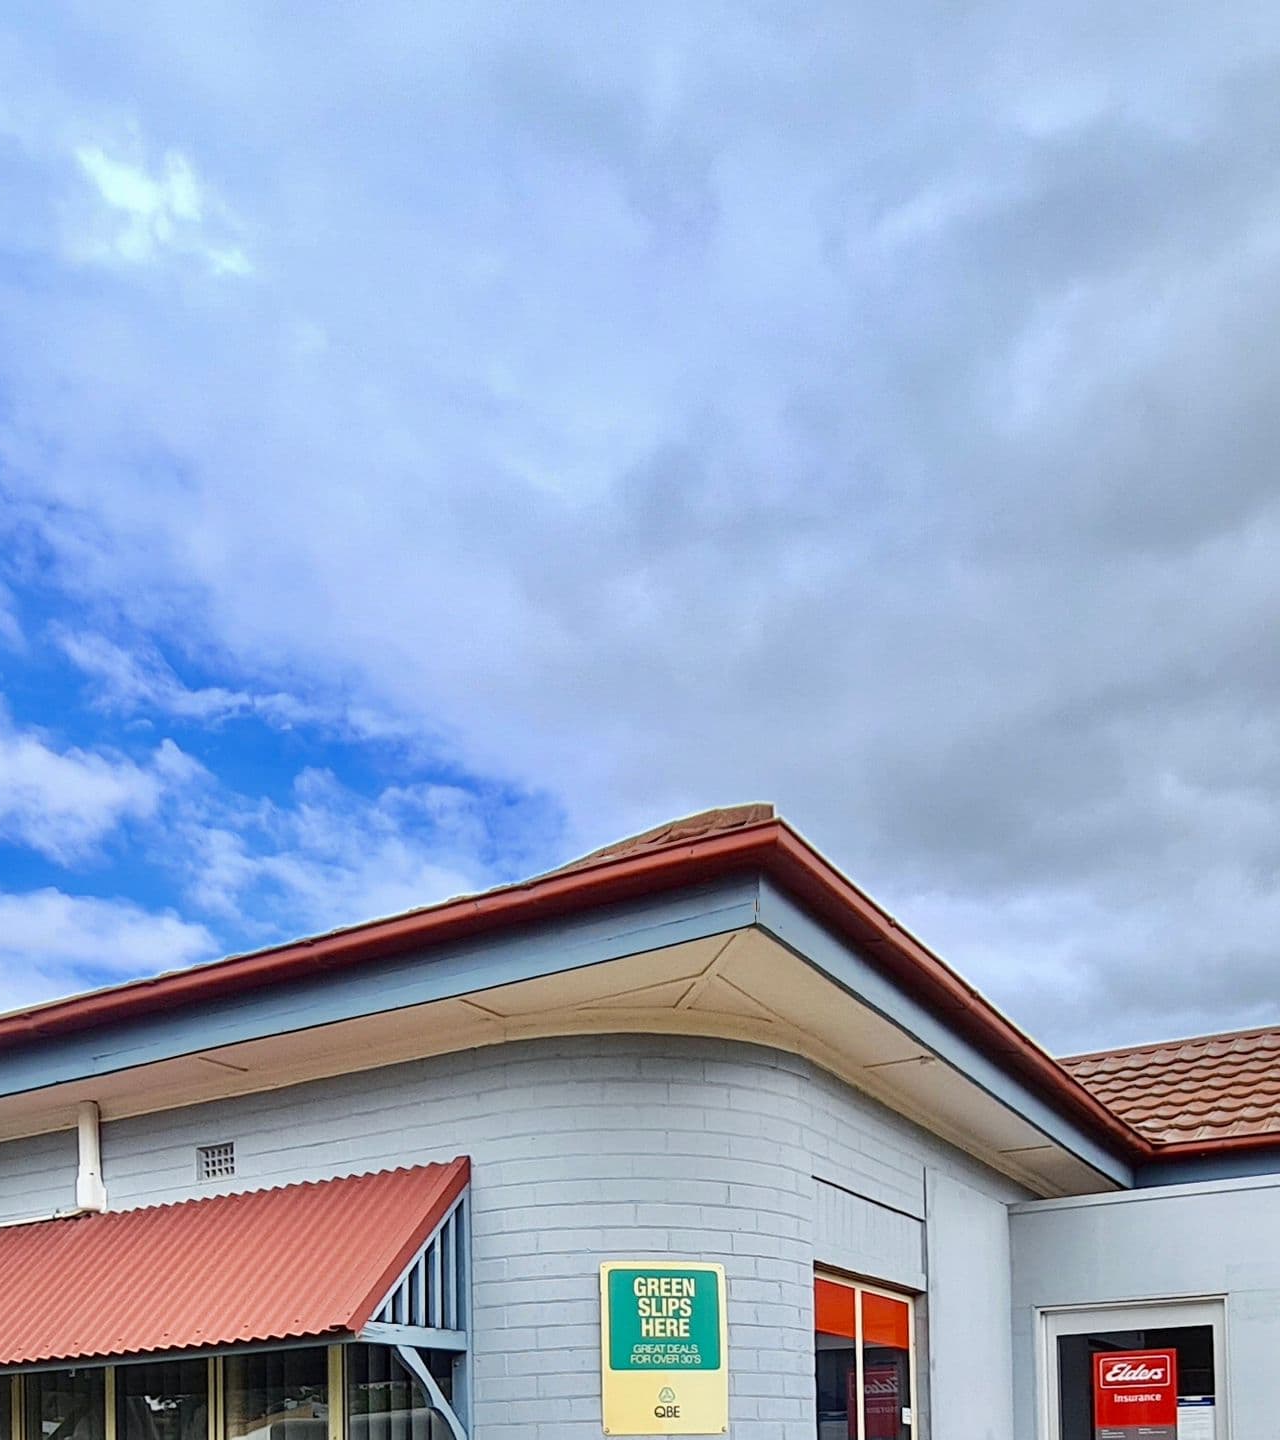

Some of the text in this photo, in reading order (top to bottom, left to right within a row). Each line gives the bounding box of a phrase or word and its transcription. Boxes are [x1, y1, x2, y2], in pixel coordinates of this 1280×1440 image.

[634, 1277, 696, 1297] GREEN
[638, 1298, 692, 1317] SLIPS
[641, 1318, 690, 1337] HERE
[633, 1344, 698, 1354] GREAT DEALS
[630, 1354, 651, 1364] FOR
[652, 1354, 679, 1364] OVER
[1105, 1363, 1165, 1382] Elders
[1113, 1393, 1162, 1403] Insurance
[654, 1405, 680, 1418] QBE
